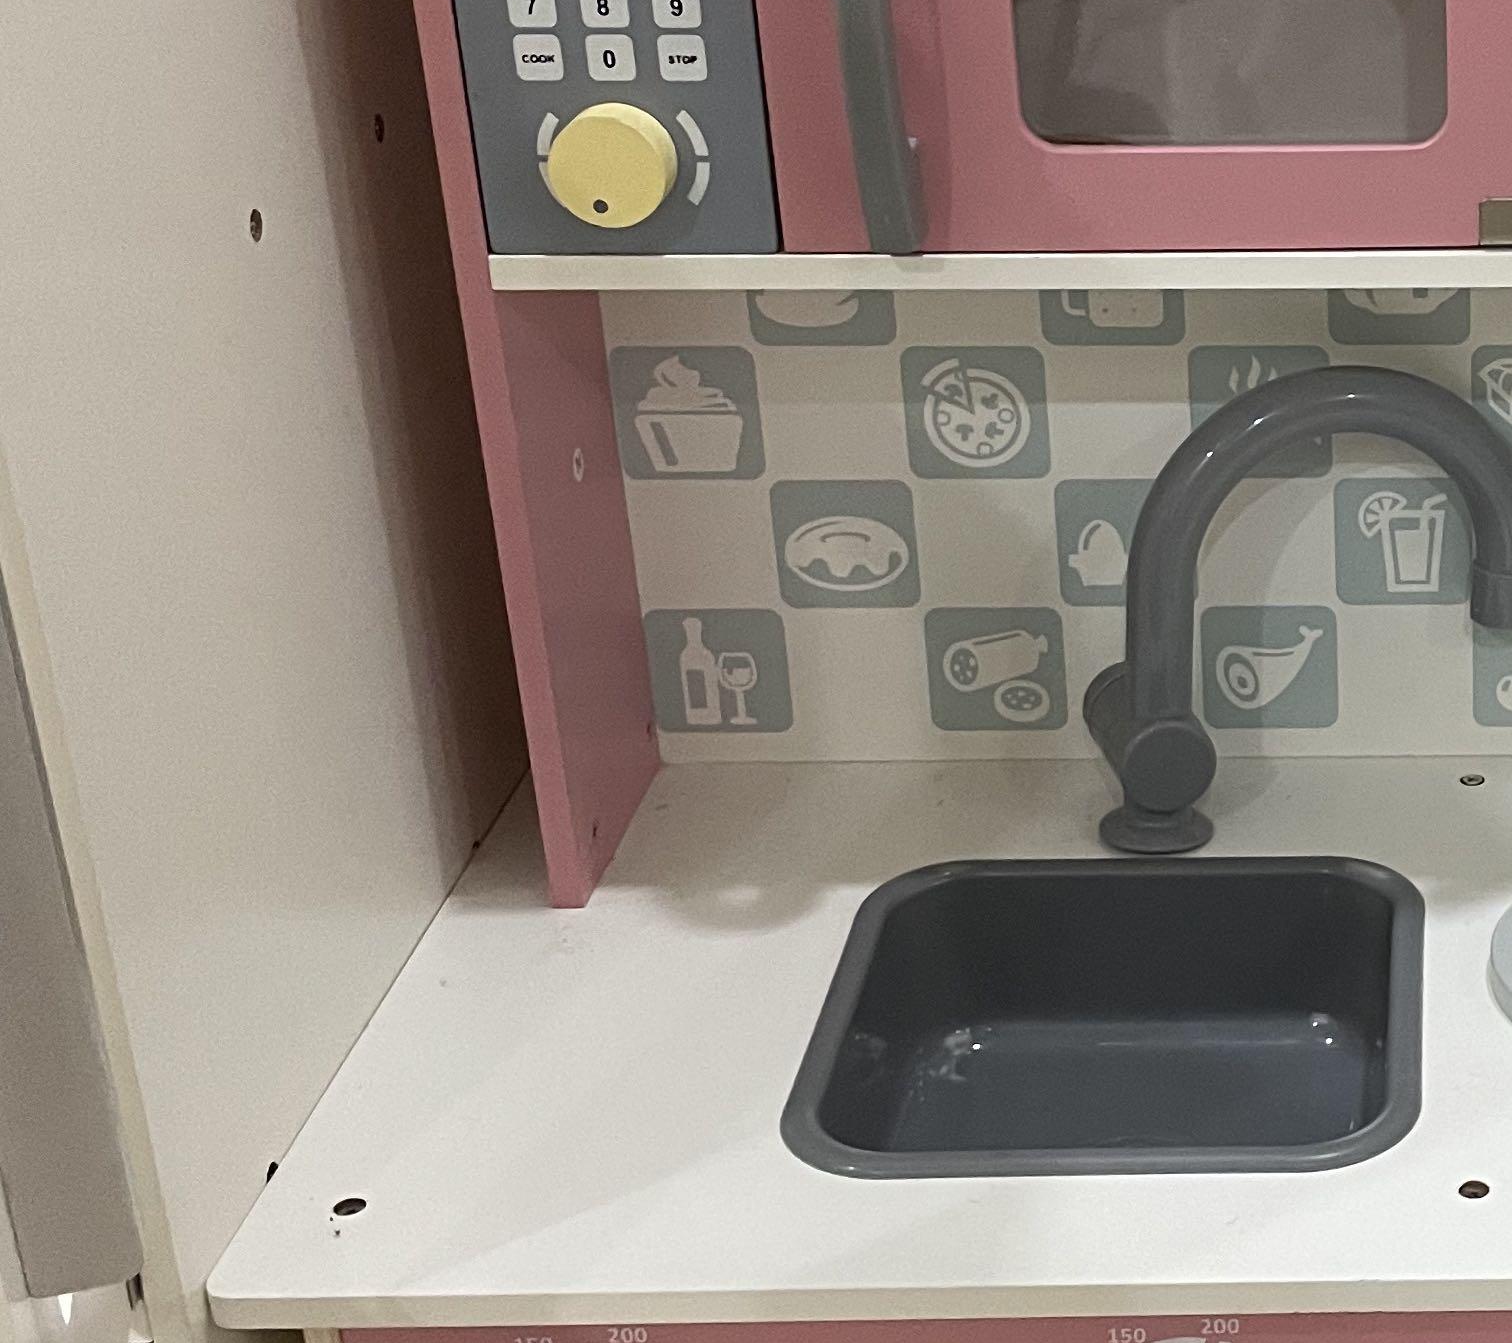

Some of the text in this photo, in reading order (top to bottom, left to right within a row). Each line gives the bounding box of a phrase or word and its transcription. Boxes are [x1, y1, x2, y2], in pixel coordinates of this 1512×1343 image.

[521, 50, 698, 68] COOK 0 STOP
[1201, 1319, 1240, 1335] 200
[608, 1328, 648, 1343] 200
[1108, 1328, 1146, 1343] 150
